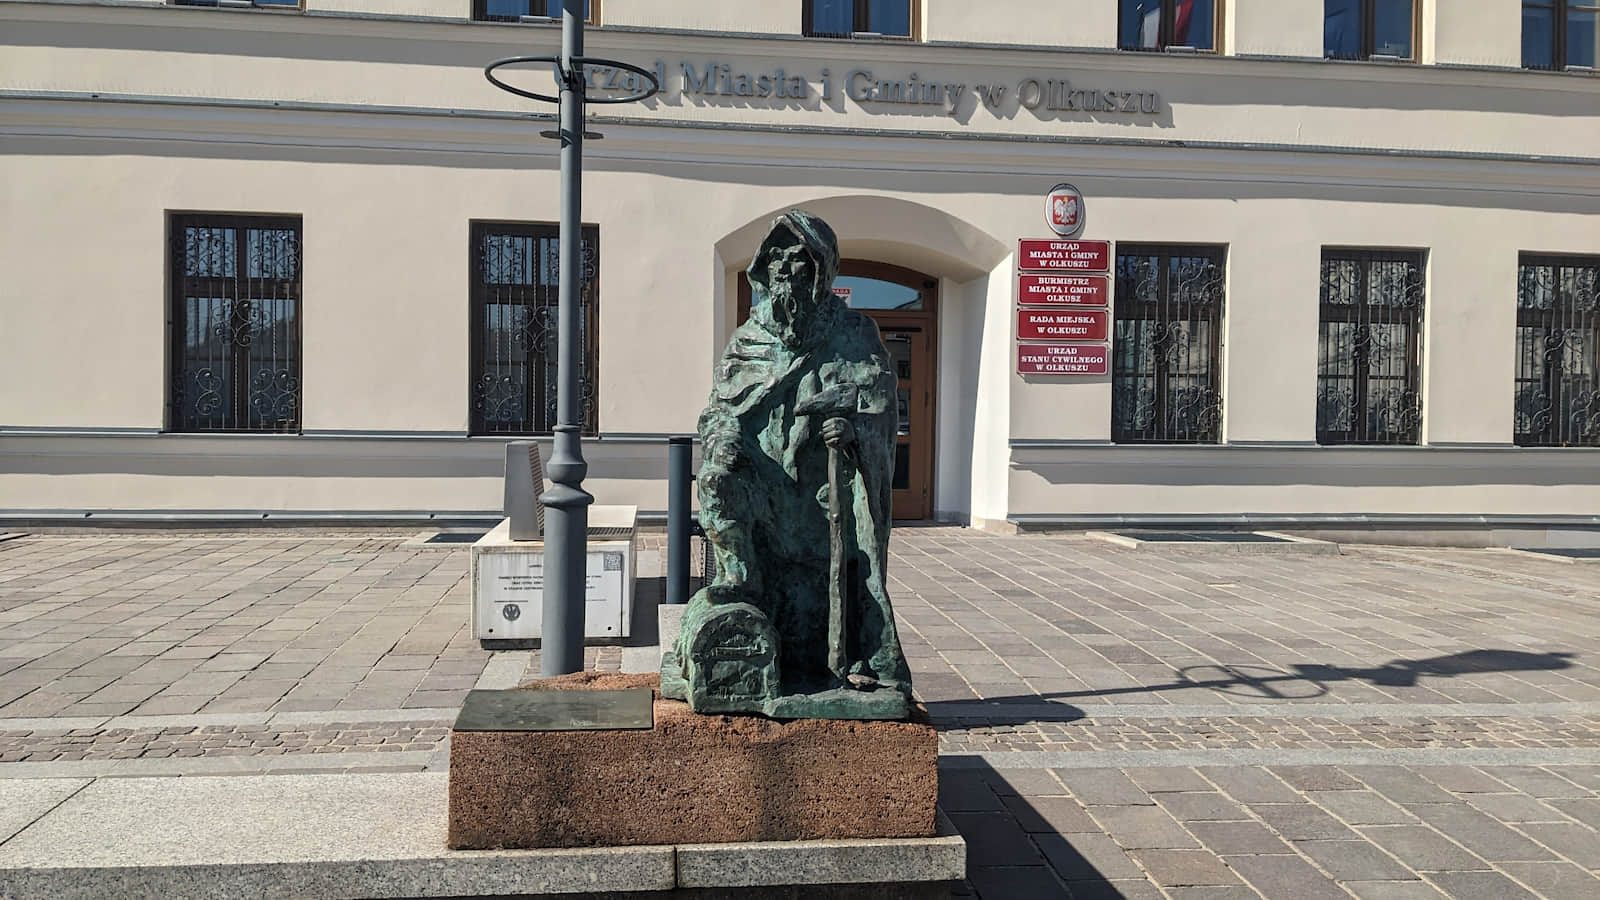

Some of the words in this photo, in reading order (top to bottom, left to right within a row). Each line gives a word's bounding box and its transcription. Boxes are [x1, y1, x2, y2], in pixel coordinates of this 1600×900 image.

[554, 58, 665, 95] rząd
[680, 60, 807, 100] Miasta
[821, 69, 832, 101] i
[847, 69, 966, 115] Gminy
[976, 85, 1006, 108] w
[1016, 78, 1161, 114] Olkuszu
[1050, 242, 1080, 251] URZĄD
[1029, 251, 1063, 259] MIASTA
[1070, 252, 1099, 260] GMINY
[1049, 260, 1089, 268] OLKUSZU
[1038, 277, 1090, 285] BURMISTRZ
[1028, 285, 1062, 293] MIASTA
[1070, 286, 1098, 294] GMINY
[1046, 294, 1082, 302] OLKUSZ
[1029, 315, 1054, 323] RADA
[1056, 316, 1096, 324] MIEJSKA
[1037, 326, 1045, 334] W
[1047, 326, 1088, 334] OLKUSZU
[1021, 355, 1050, 363] STANU
[1052, 356, 1103, 364] CYWILNEGO
[1046, 364, 1089, 372] OLKUSZU
